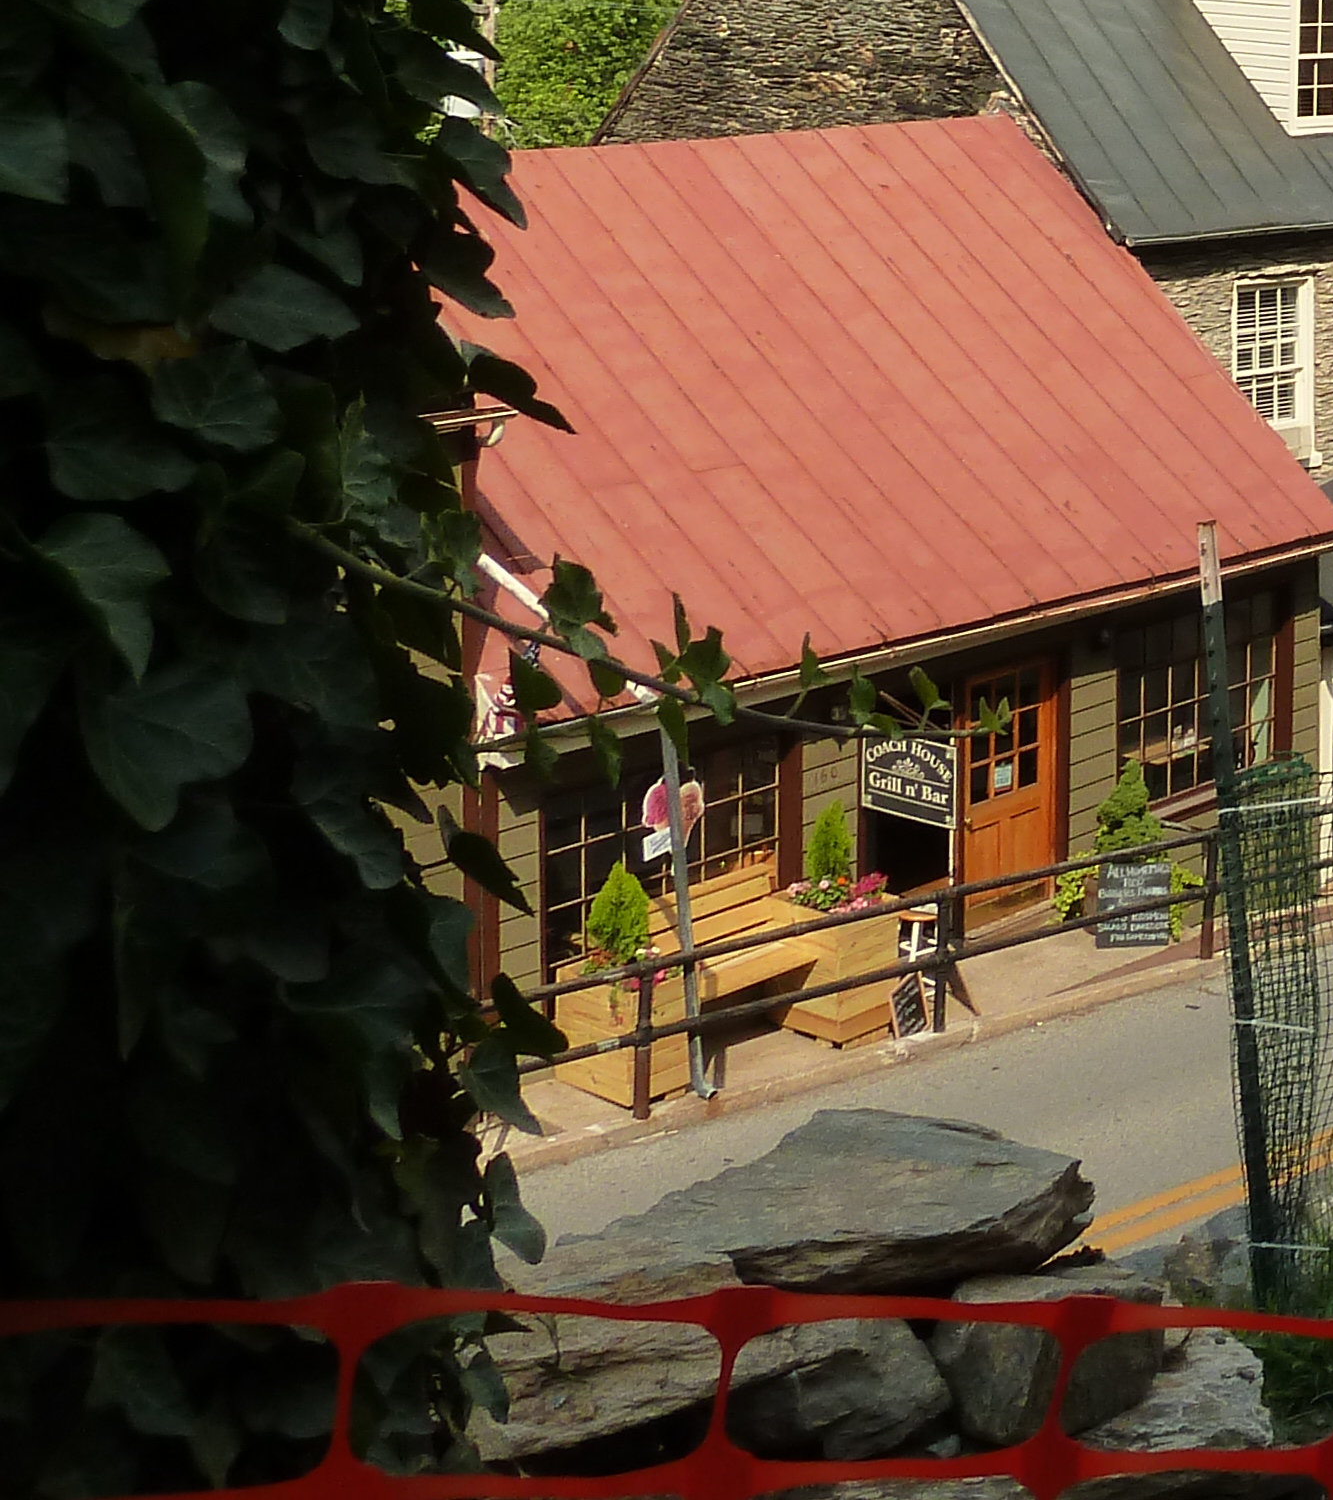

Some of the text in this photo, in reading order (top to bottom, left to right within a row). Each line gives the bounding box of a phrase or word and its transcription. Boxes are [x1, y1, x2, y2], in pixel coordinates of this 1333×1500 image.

[866, 739, 953, 783] COACH HOUSE
[868, 771, 949, 805] Grill n' Bar
